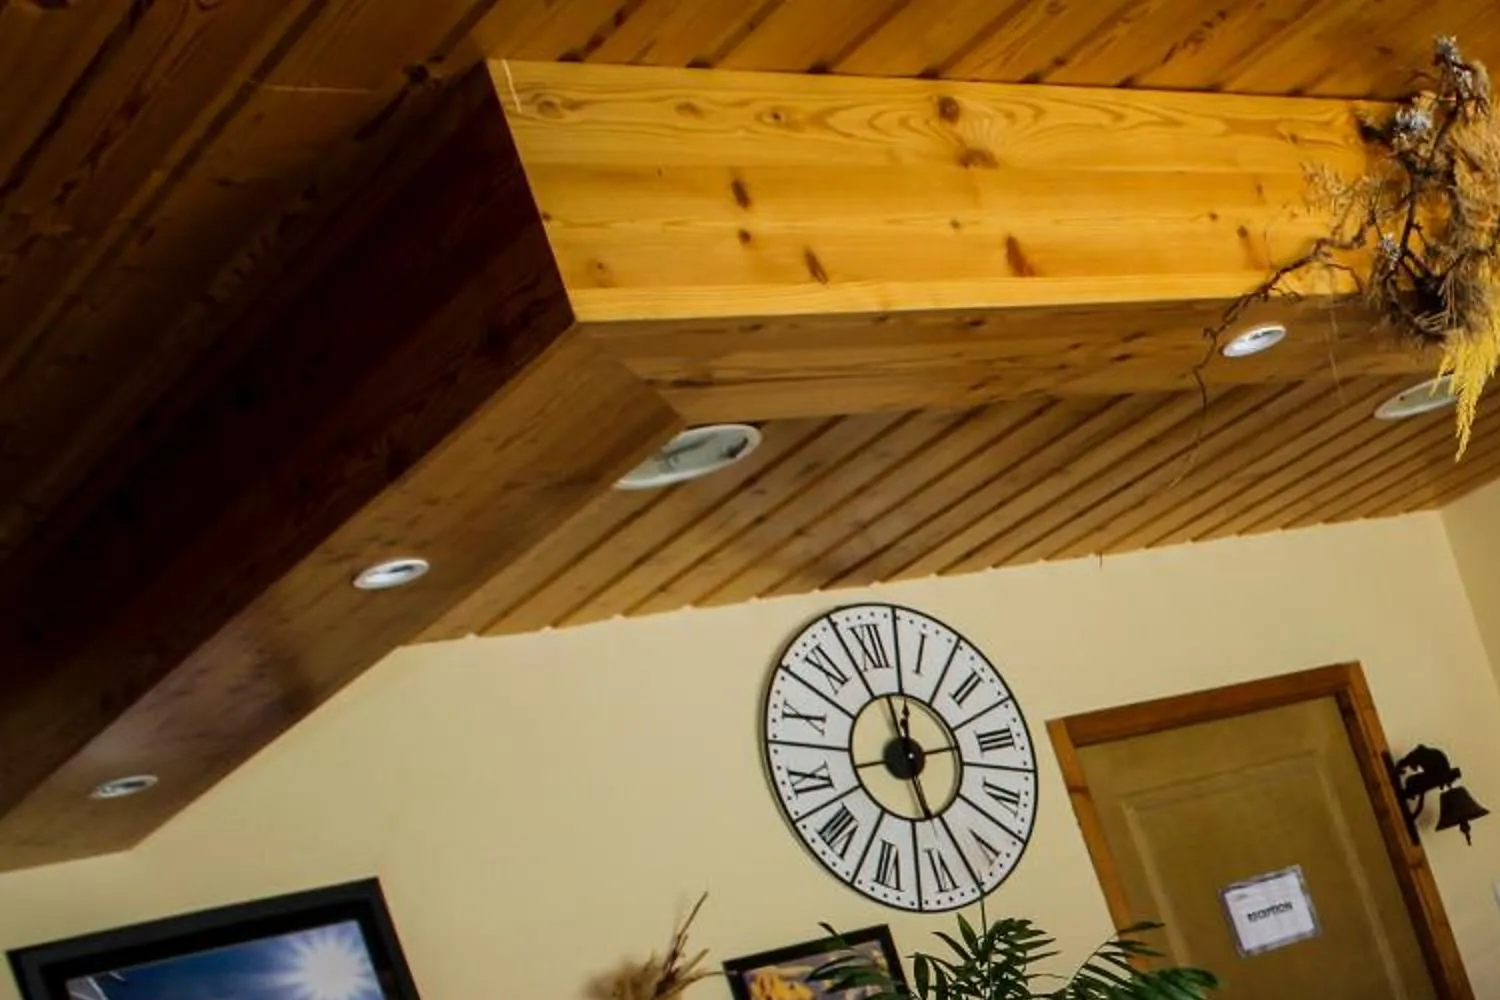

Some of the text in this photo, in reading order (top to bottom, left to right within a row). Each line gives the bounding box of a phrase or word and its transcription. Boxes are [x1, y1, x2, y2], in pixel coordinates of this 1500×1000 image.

[850, 623, 892, 672] XII
[803, 643, 852, 695] XI
[949, 670, 984, 708] II
[781, 700, 827, 736] X
[976, 727, 1017, 754] III
